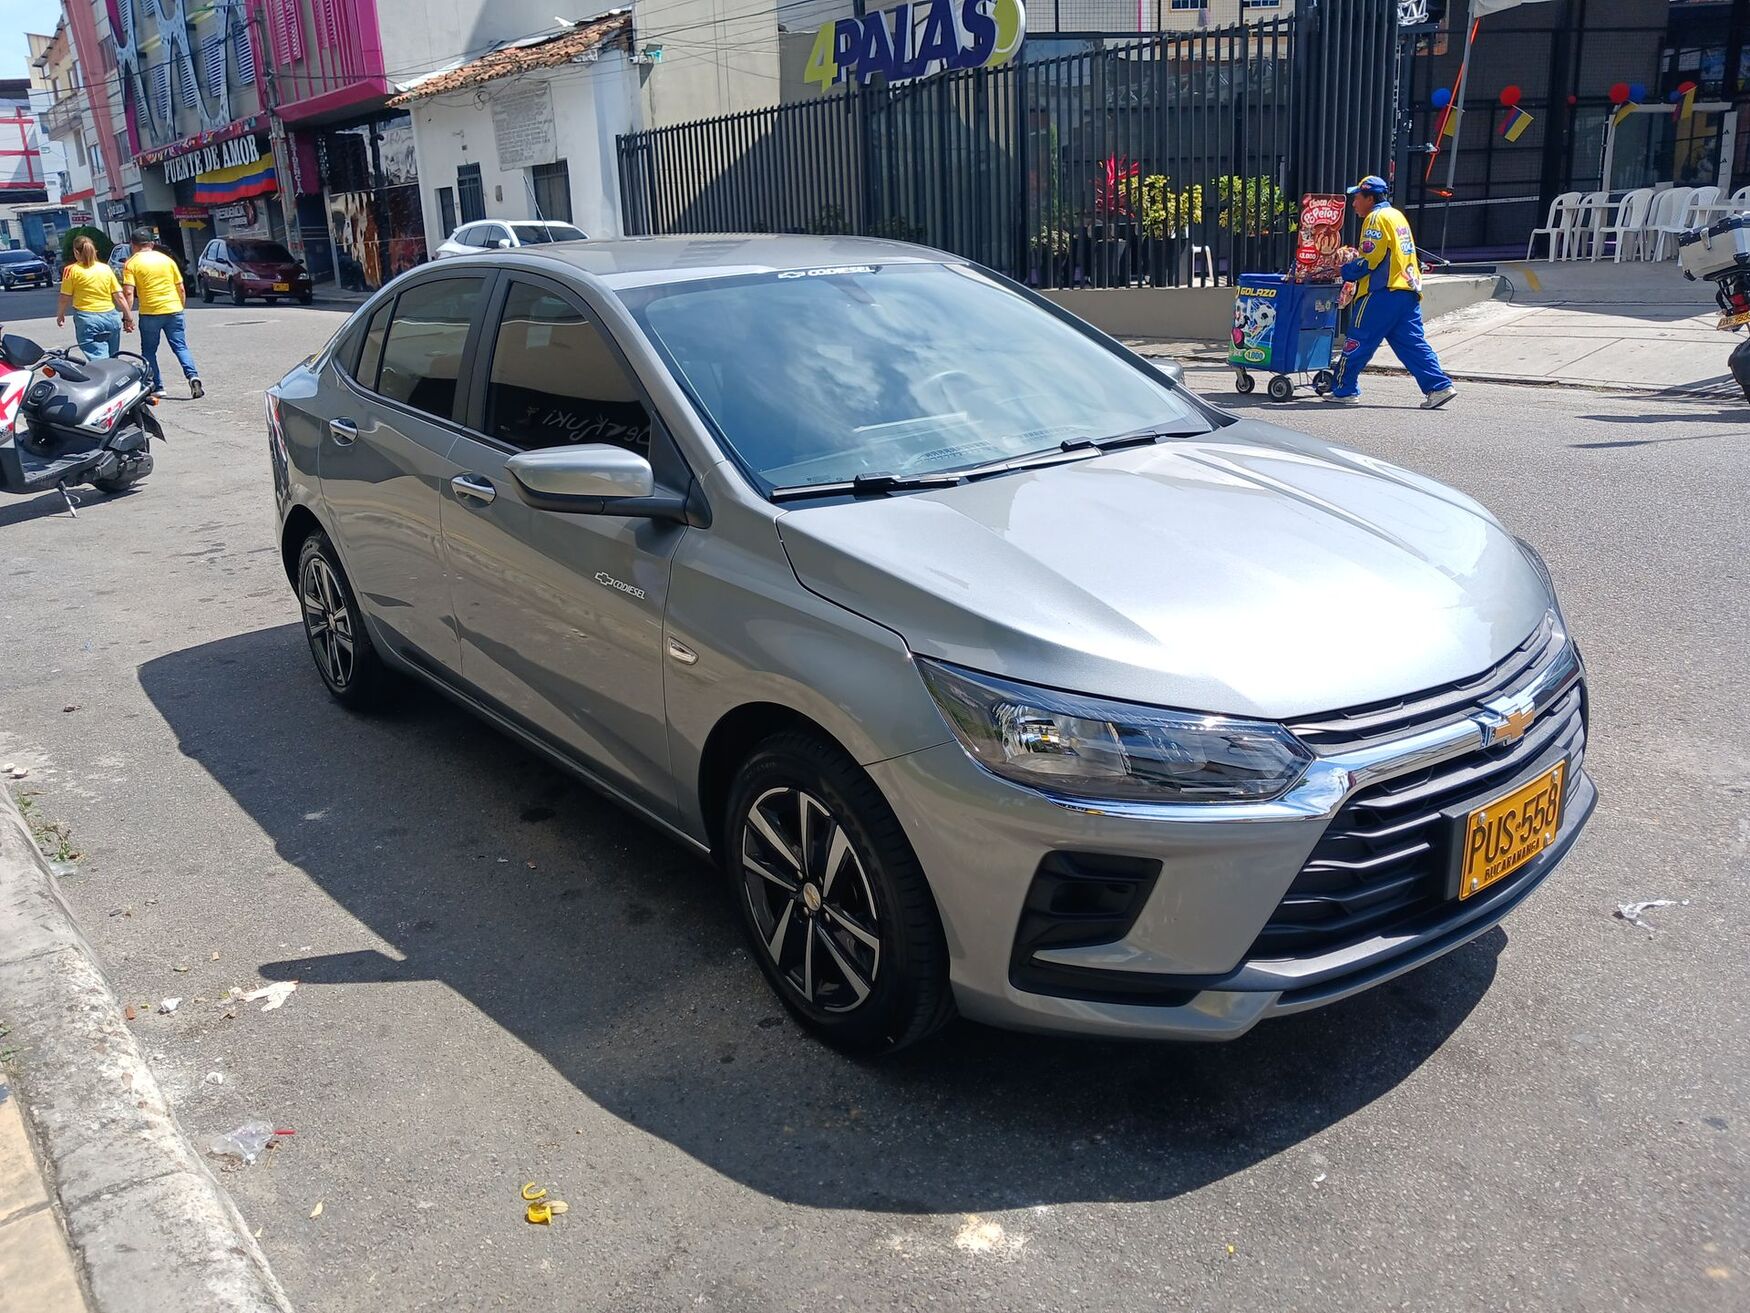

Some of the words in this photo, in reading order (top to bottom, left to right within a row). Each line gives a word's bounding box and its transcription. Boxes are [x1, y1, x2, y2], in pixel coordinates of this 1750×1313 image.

[204, 145, 220, 172] DE
[222, 134, 260, 168] AMOR
[1240, 287, 1277, 298] GOLAZO
[613, 579, 646, 600] CODIESEL
[1484, 837, 1540, 881] BUCARAMANGA
